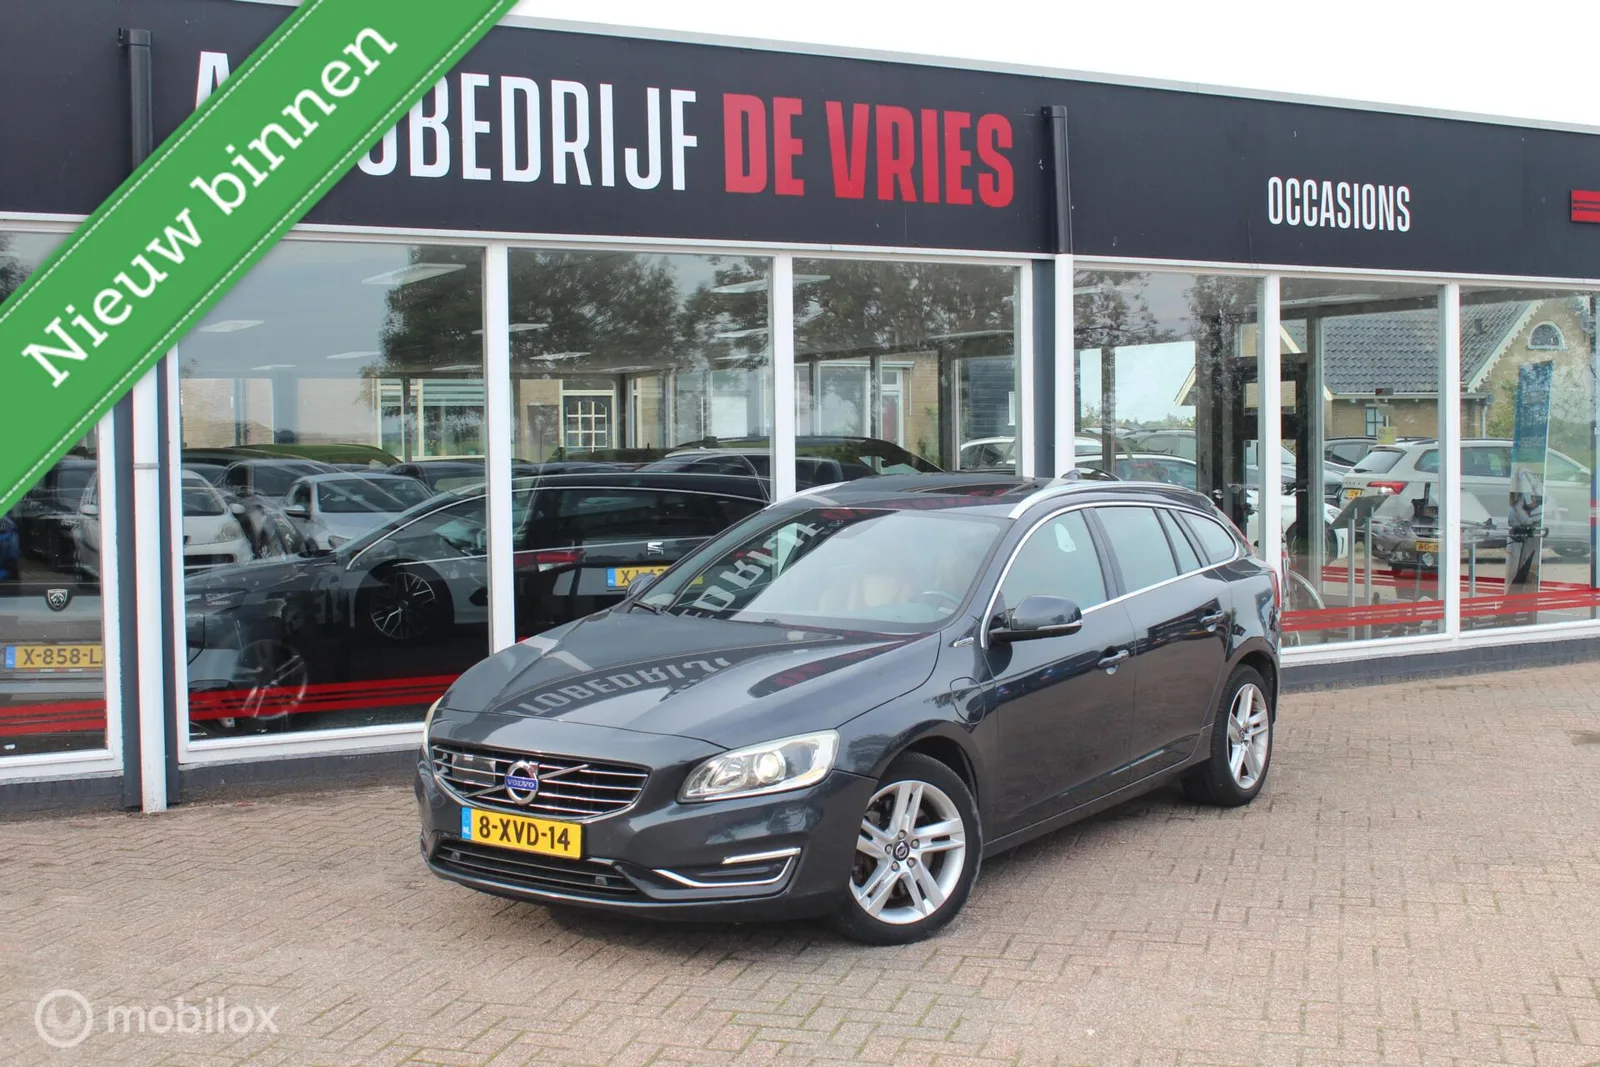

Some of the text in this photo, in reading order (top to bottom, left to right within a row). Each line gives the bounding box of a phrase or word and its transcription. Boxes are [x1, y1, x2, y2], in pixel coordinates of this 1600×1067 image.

[195, 51, 1014, 208] BEDRIJF DE VRIES
[1268, 176, 1411, 232] OCCASIONS
[23, 647, 104, 666] X-858-L
[506, 778, 535, 788] VOLVO
[479, 815, 571, 851] 8-XVD-14
